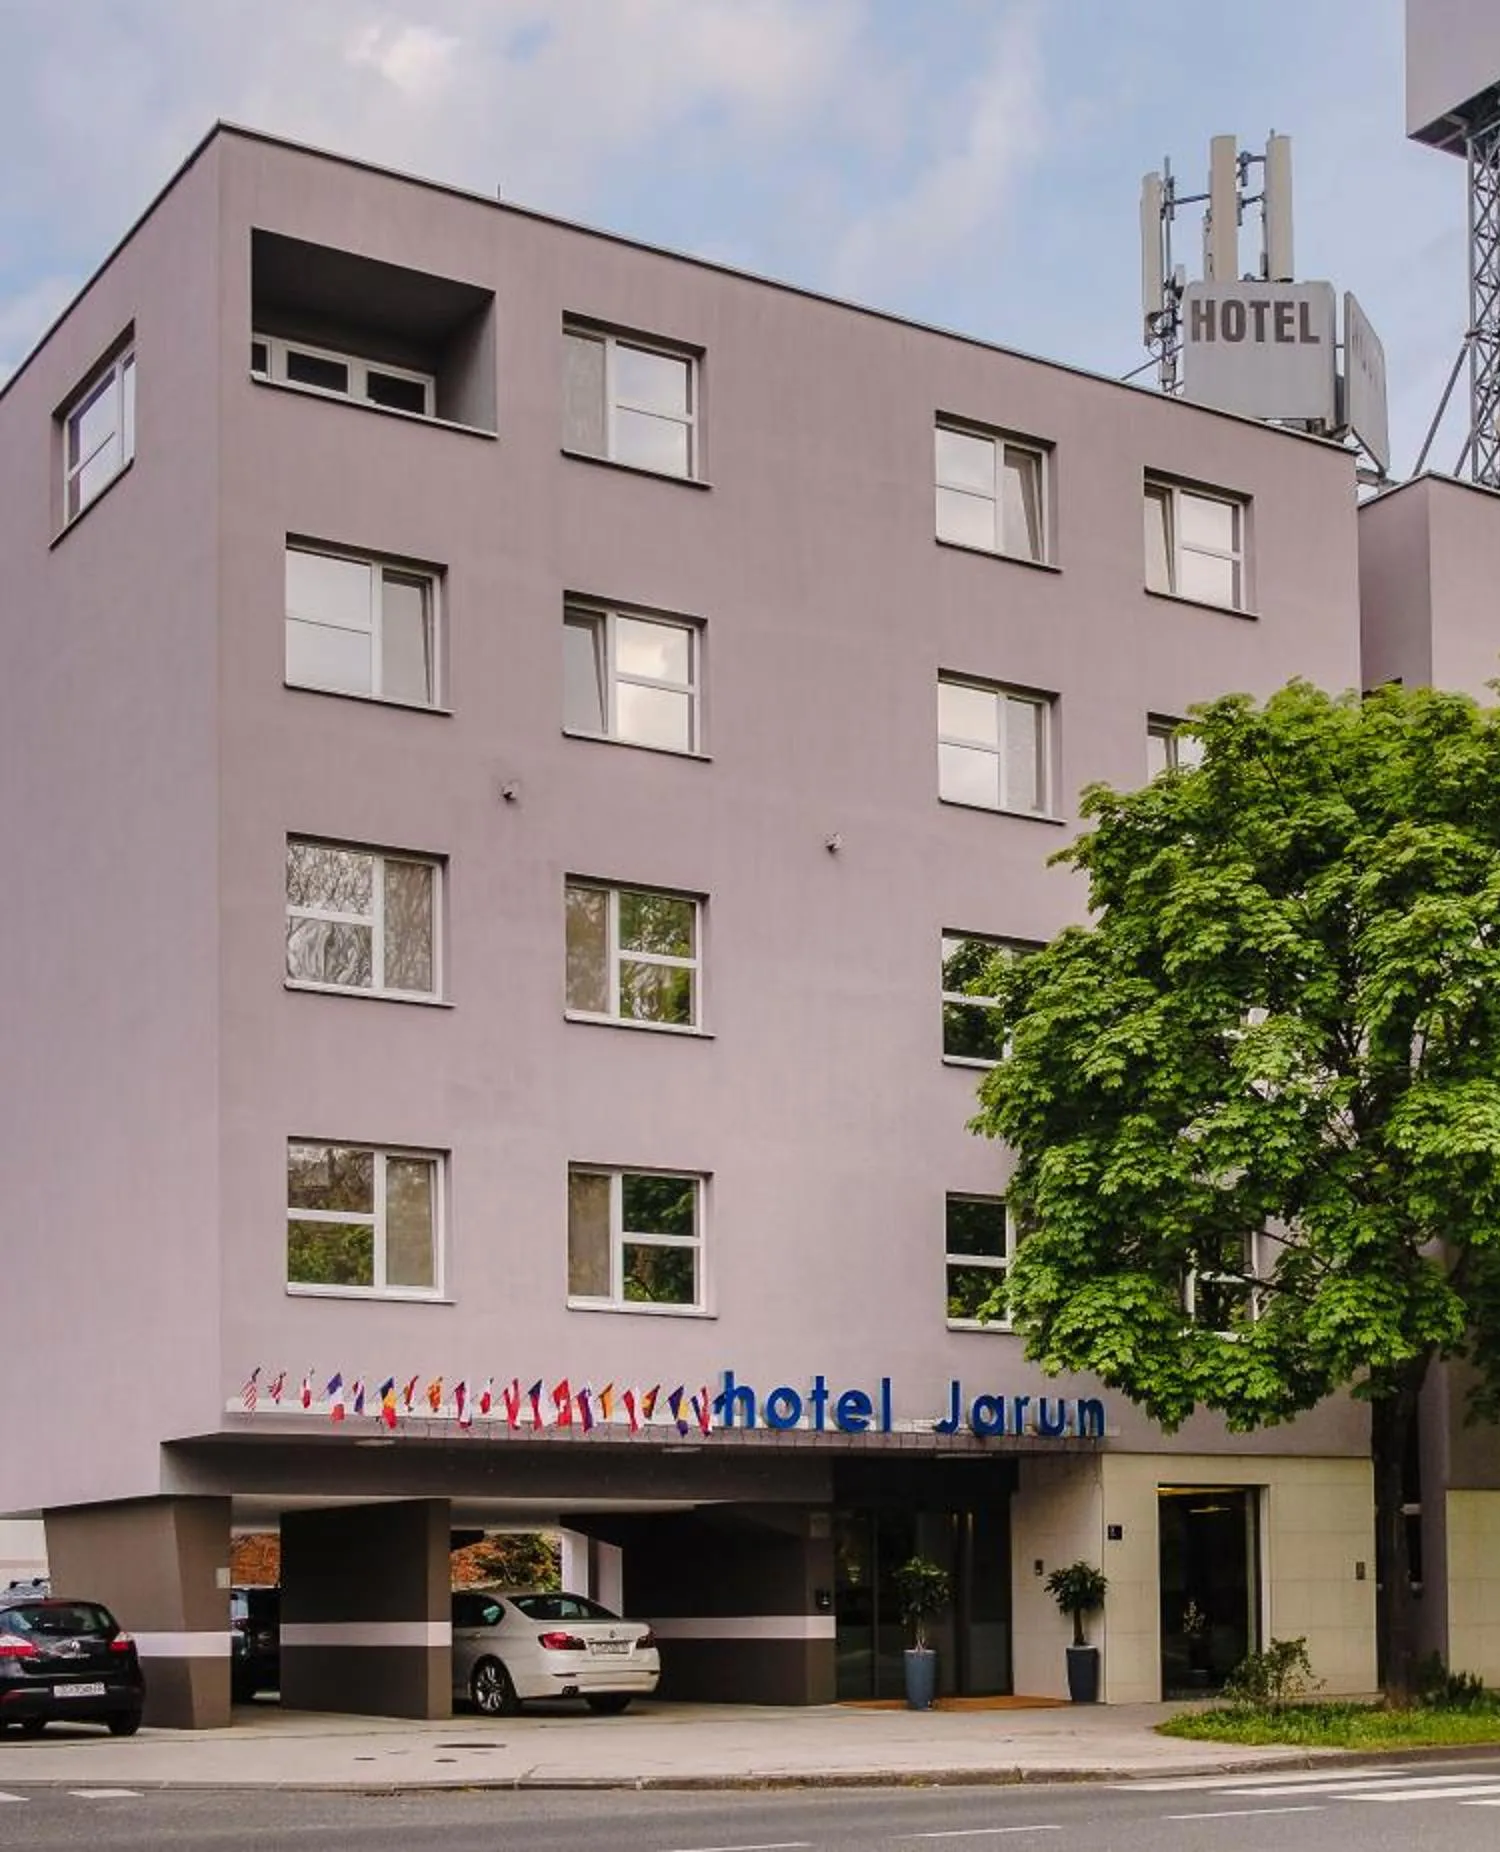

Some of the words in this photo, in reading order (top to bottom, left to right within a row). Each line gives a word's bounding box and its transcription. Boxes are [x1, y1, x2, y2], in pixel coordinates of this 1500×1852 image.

[1191, 299, 1321, 343] HOTEL
[720, 1370, 892, 1433] hotel
[933, 1379, 1106, 1438] Jarun
